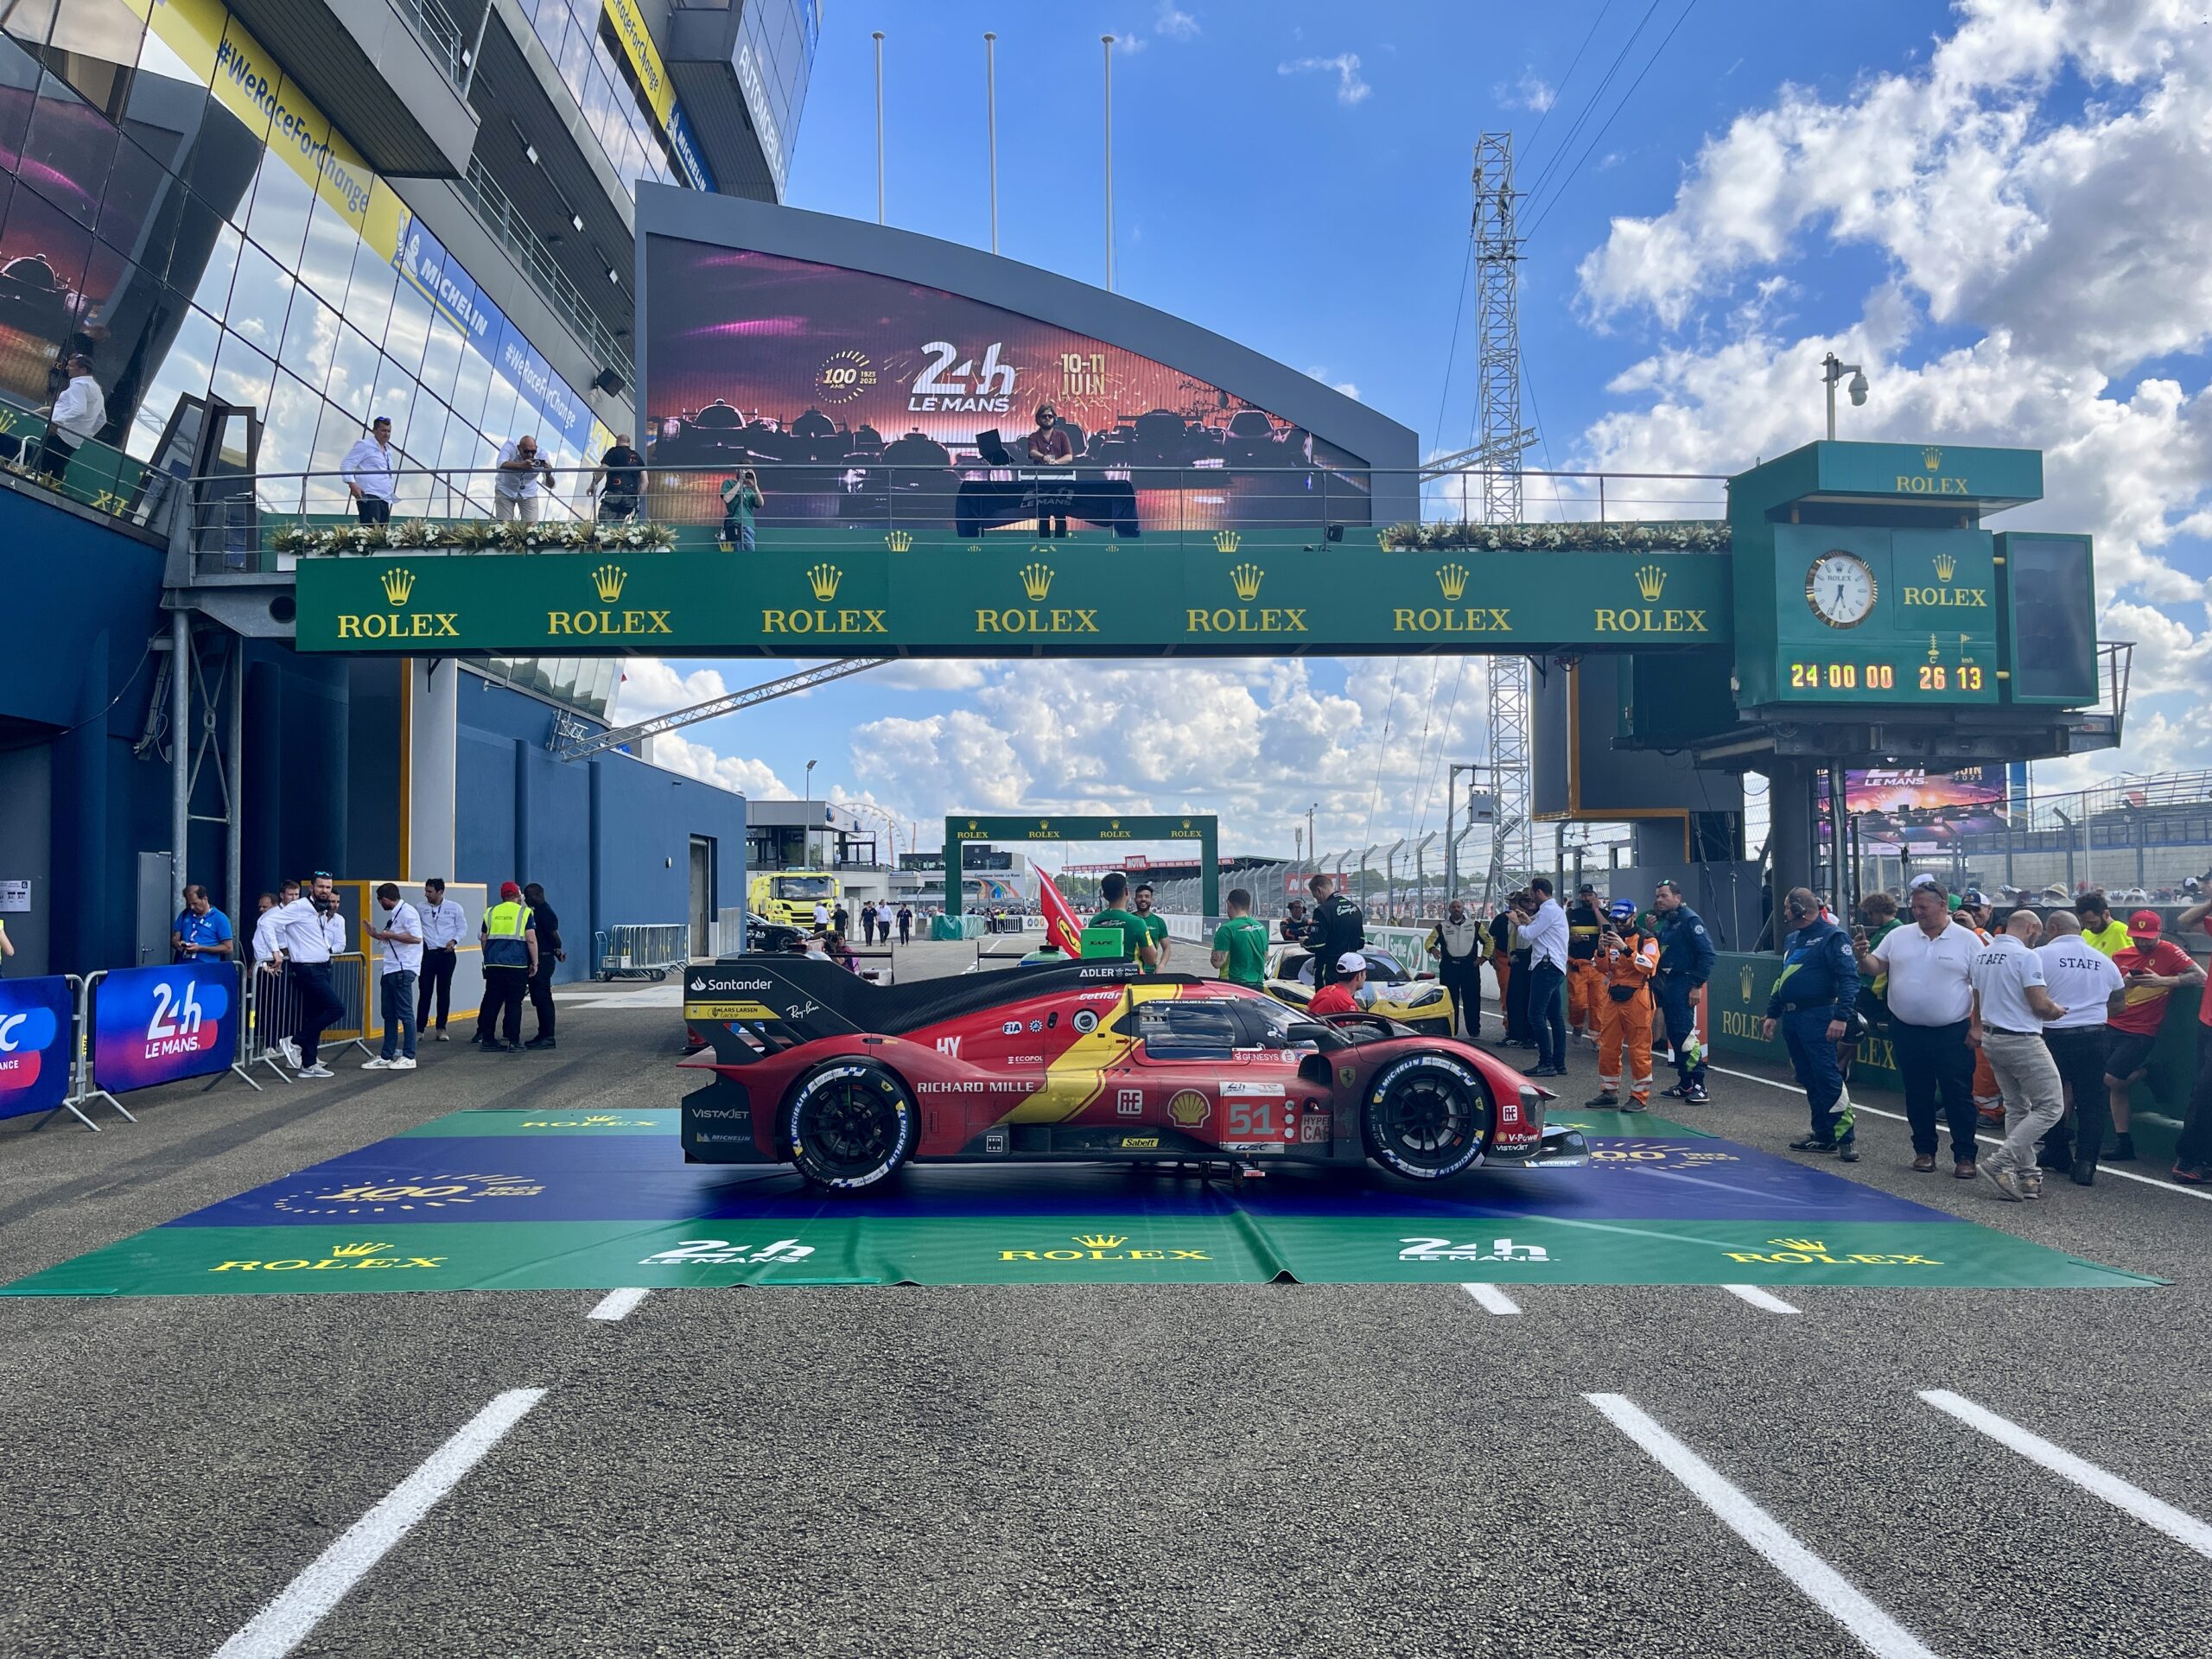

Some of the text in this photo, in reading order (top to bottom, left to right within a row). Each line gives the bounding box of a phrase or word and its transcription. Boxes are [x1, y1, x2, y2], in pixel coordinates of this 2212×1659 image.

[612, 0, 658, 92] RaceForChange
[217, 39, 369, 214] #WeRaceForChange
[677, 130, 707, 191] MICHELIN
[420, 257, 487, 337] MICHELIN
[912, 341, 1015, 396] 24h
[1060, 353, 1105, 373] 10-11
[505, 342, 576, 429] #WeRaceForChange
[823, 368, 857, 385] 100
[1061, 373, 1105, 395] JUIN
[908, 397, 1010, 412] LE MANS
[1896, 476, 1969, 493] ROLEX
[1904, 588, 1987, 607] ROLEX
[338, 614, 460, 639] ROLEX
[548, 610, 673, 635] ROLEX
[762, 609, 889, 633] ROLEX
[976, 609, 1100, 633] ROLEX
[1187, 608, 1309, 632] ROLEX
[1394, 607, 1512, 632] ROLEX
[1595, 610, 1709, 632] ROLEX
[1866, 665, 1892, 689] 00
[1920, 667, 1945, 690] 26
[1957, 667, 1981, 690] 13
[1884, 778, 1924, 786] MANS
[1079, 969, 1114, 977] ADLER
[2059, 958, 2101, 970] STAFF
[709, 979, 772, 990] Santander
[147, 980, 202, 1040] 24h
[786, 1001, 820, 1019] Ray-Ban
[145, 1036, 198, 1059] LE MANS
[1856, 1036, 1897, 1071] LEX
[1382, 1058, 1420, 1087] MICHELIN
[918, 1082, 1034, 1092] RICHARD MILLE
[692, 1107, 749, 1119] VISTAJET
[791, 1090, 808, 1138] MICHELIN
[1230, 1104, 1274, 1135] 51
[888, 1119, 906, 1166] MICHELIN
[1440, 1147, 1476, 1175] MICHELIN
[1591, 1151, 1649, 1160] 00
[315, 1185, 469, 1198] 100
[649, 1238, 815, 1258] 24h
[998, 1249, 1212, 1262] ROLEX
[1398, 1237, 1547, 1255] 24h
[208, 1256, 448, 1271] ROLEX
[1722, 1252, 1945, 1265] ROLEX
